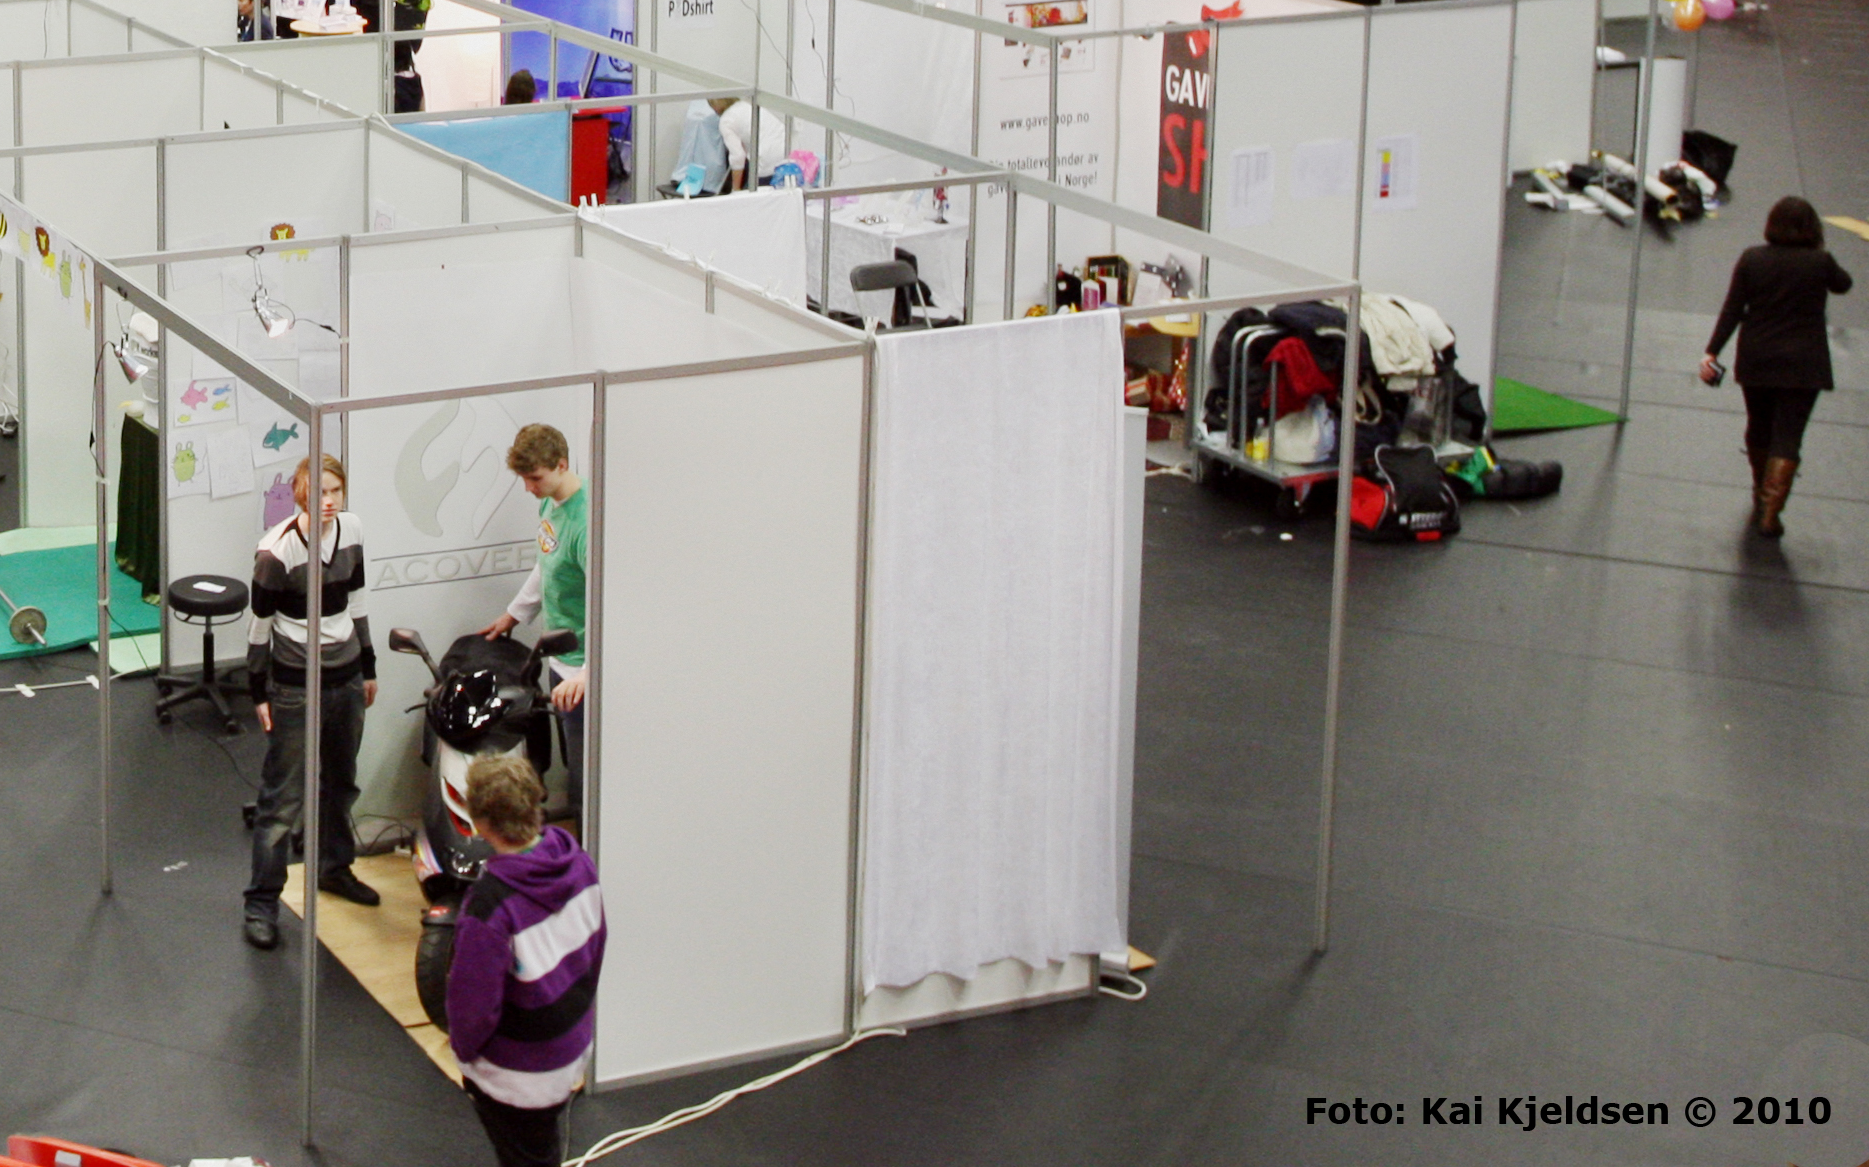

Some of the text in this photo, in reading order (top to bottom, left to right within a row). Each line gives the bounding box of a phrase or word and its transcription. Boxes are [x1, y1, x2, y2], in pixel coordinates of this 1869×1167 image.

[1165, 64, 1210, 110] GAV
[1000, 112, 1090, 131] www.gaveop.no
[1007, 152, 1084, 171] totalleveandør
[1088, 154, 1099, 164] av
[1065, 171, 1098, 188] Norge!
